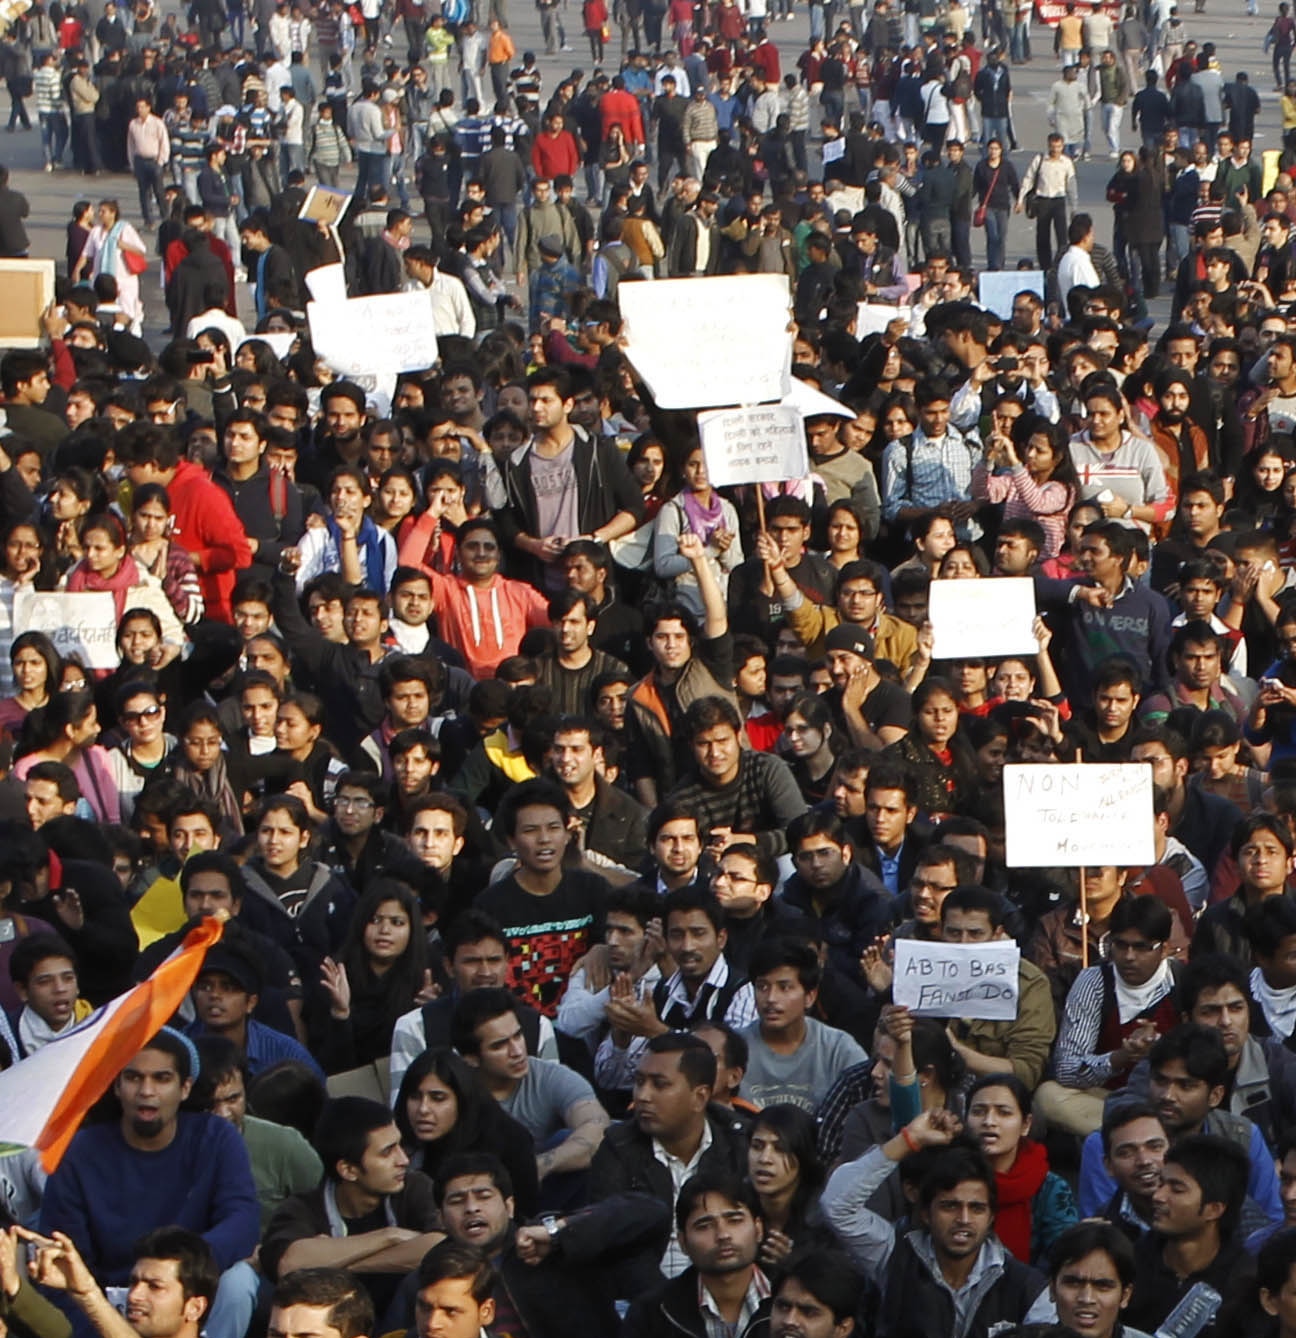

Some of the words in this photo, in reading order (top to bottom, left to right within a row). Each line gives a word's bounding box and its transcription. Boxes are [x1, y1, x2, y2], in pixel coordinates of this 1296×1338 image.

[905, 956, 934, 977] AB
[936, 959, 959, 978] TO
[970, 959, 1009, 978] BAS
[980, 983, 1014, 1000] DO
